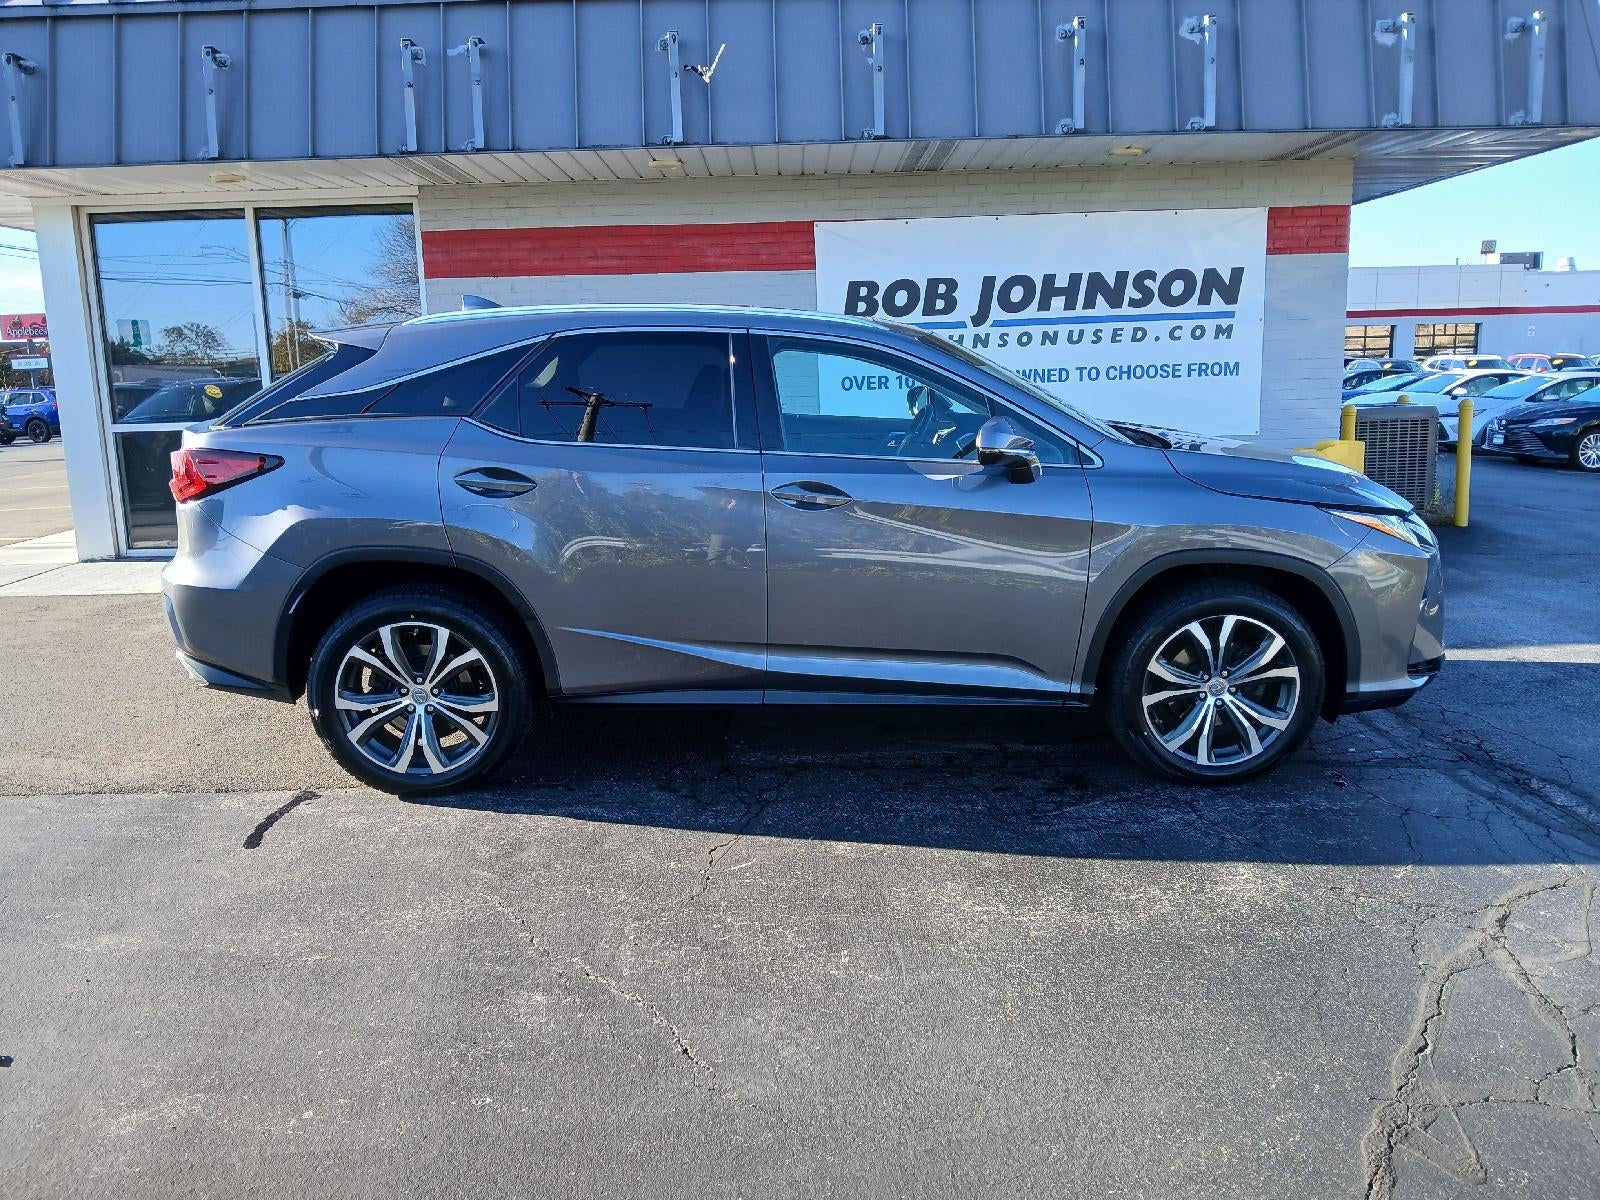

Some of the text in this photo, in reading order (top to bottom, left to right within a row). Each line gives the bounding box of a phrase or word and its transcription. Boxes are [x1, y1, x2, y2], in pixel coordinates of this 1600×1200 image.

[844, 267, 1245, 328] BOB JOHNSON
[841, 375, 890, 392] OVER
[1075, 366, 1101, 382] TO
[1105, 363, 1183, 382] CHOOSE
[1187, 362, 1240, 378] FROM
